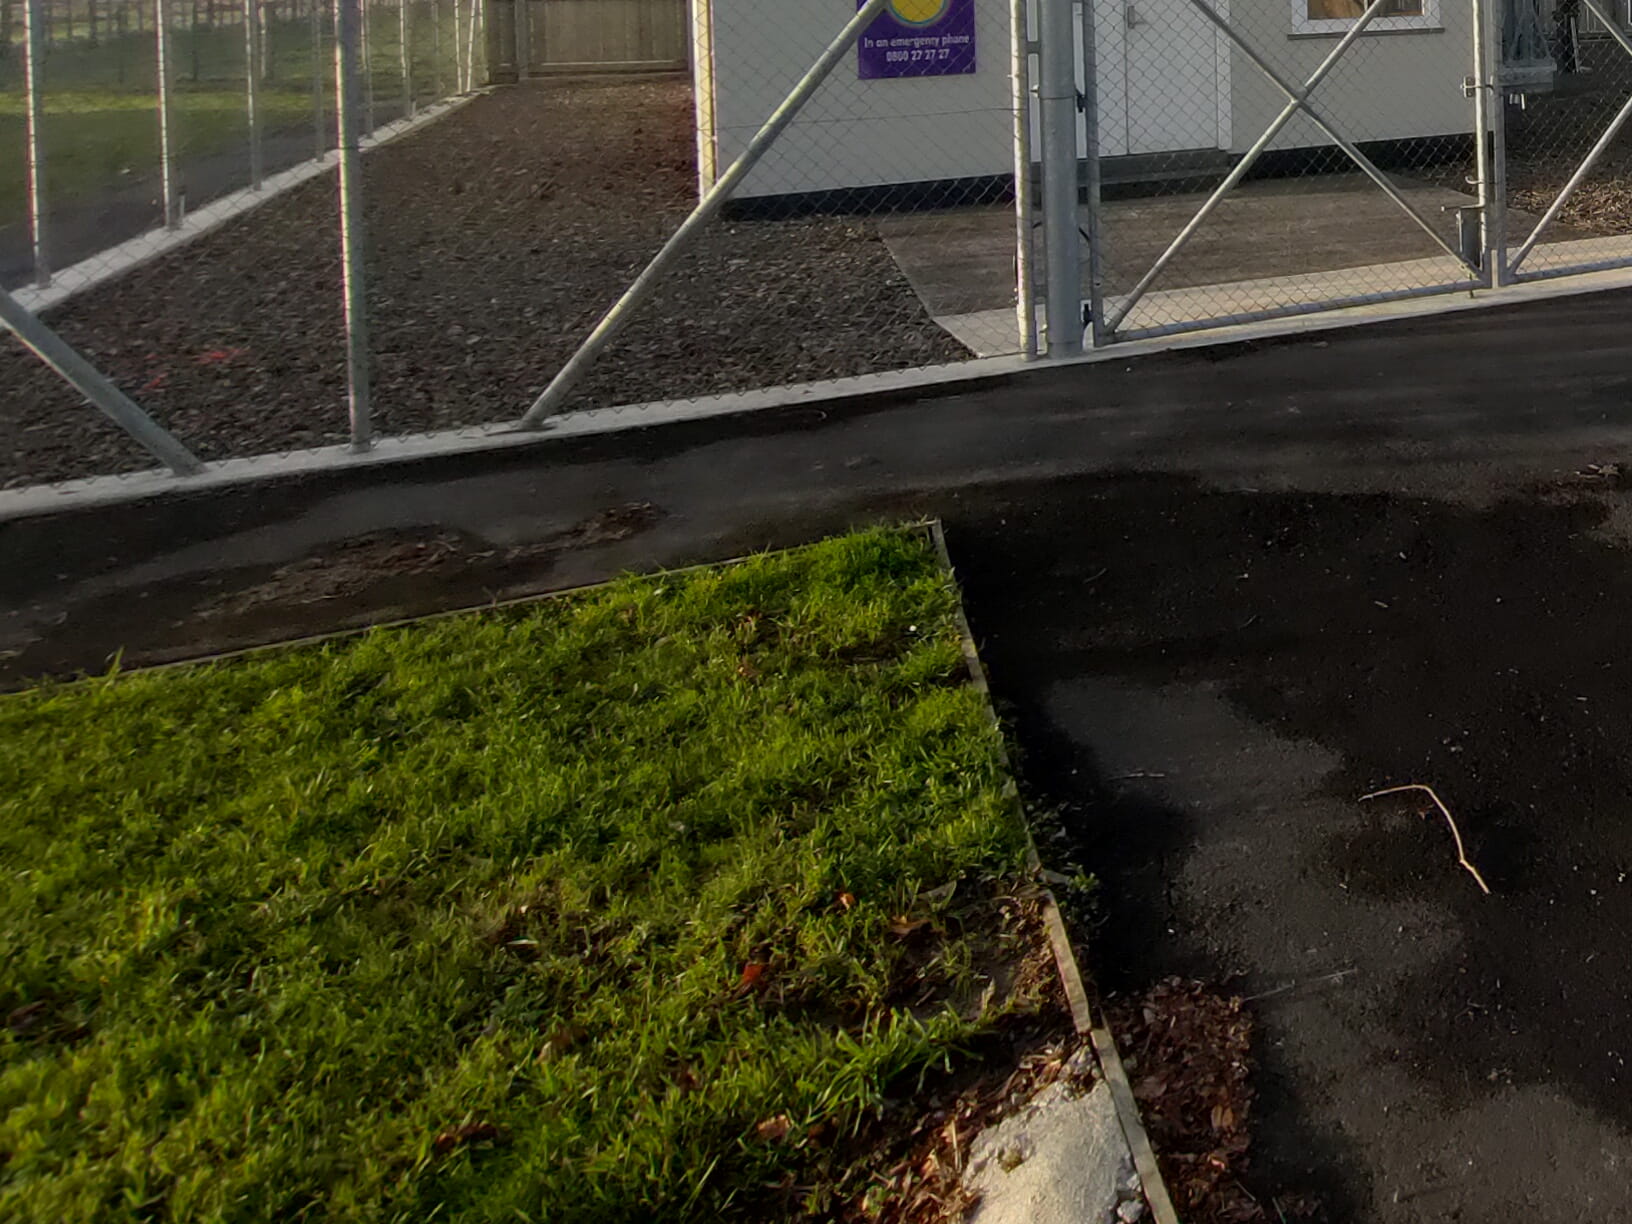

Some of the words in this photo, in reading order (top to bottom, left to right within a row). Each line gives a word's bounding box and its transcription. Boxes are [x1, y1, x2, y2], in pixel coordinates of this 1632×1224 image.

[864, 37, 874, 48] In
[876, 39, 888, 47] an
[891, 36, 939, 48] emergency
[942, 33, 970, 47] phone
[911, 50, 922, 61] 27
[925, 49, 936, 60] 27
[939, 49, 950, 59] 27
